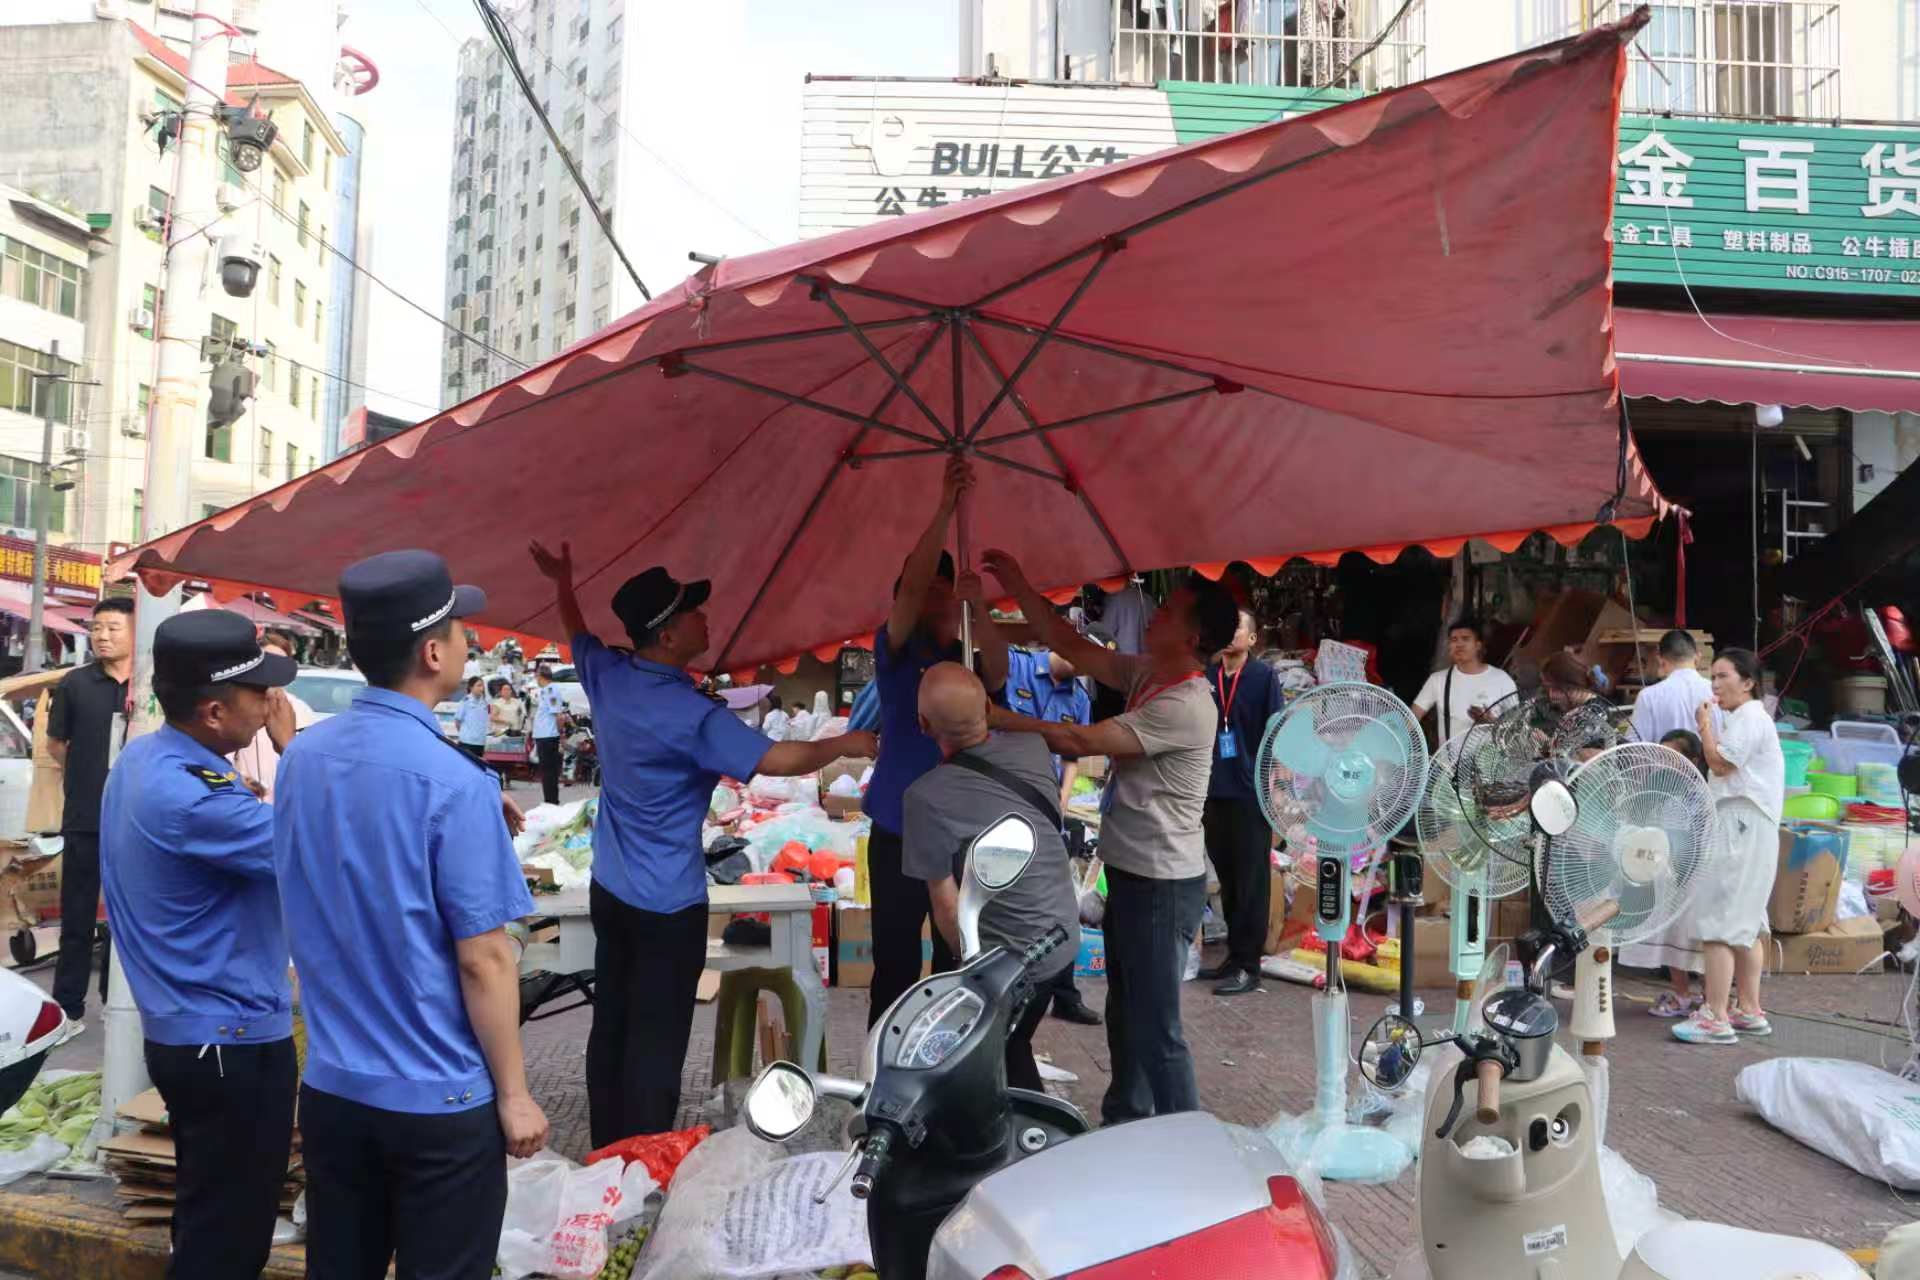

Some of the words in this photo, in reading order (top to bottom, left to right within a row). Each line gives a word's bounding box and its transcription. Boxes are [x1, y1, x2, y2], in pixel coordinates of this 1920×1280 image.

[875, 186, 991, 215] 公牛
[1612, 222, 1692, 248] 金工具
[1723, 229, 1813, 254] 塑料制品
